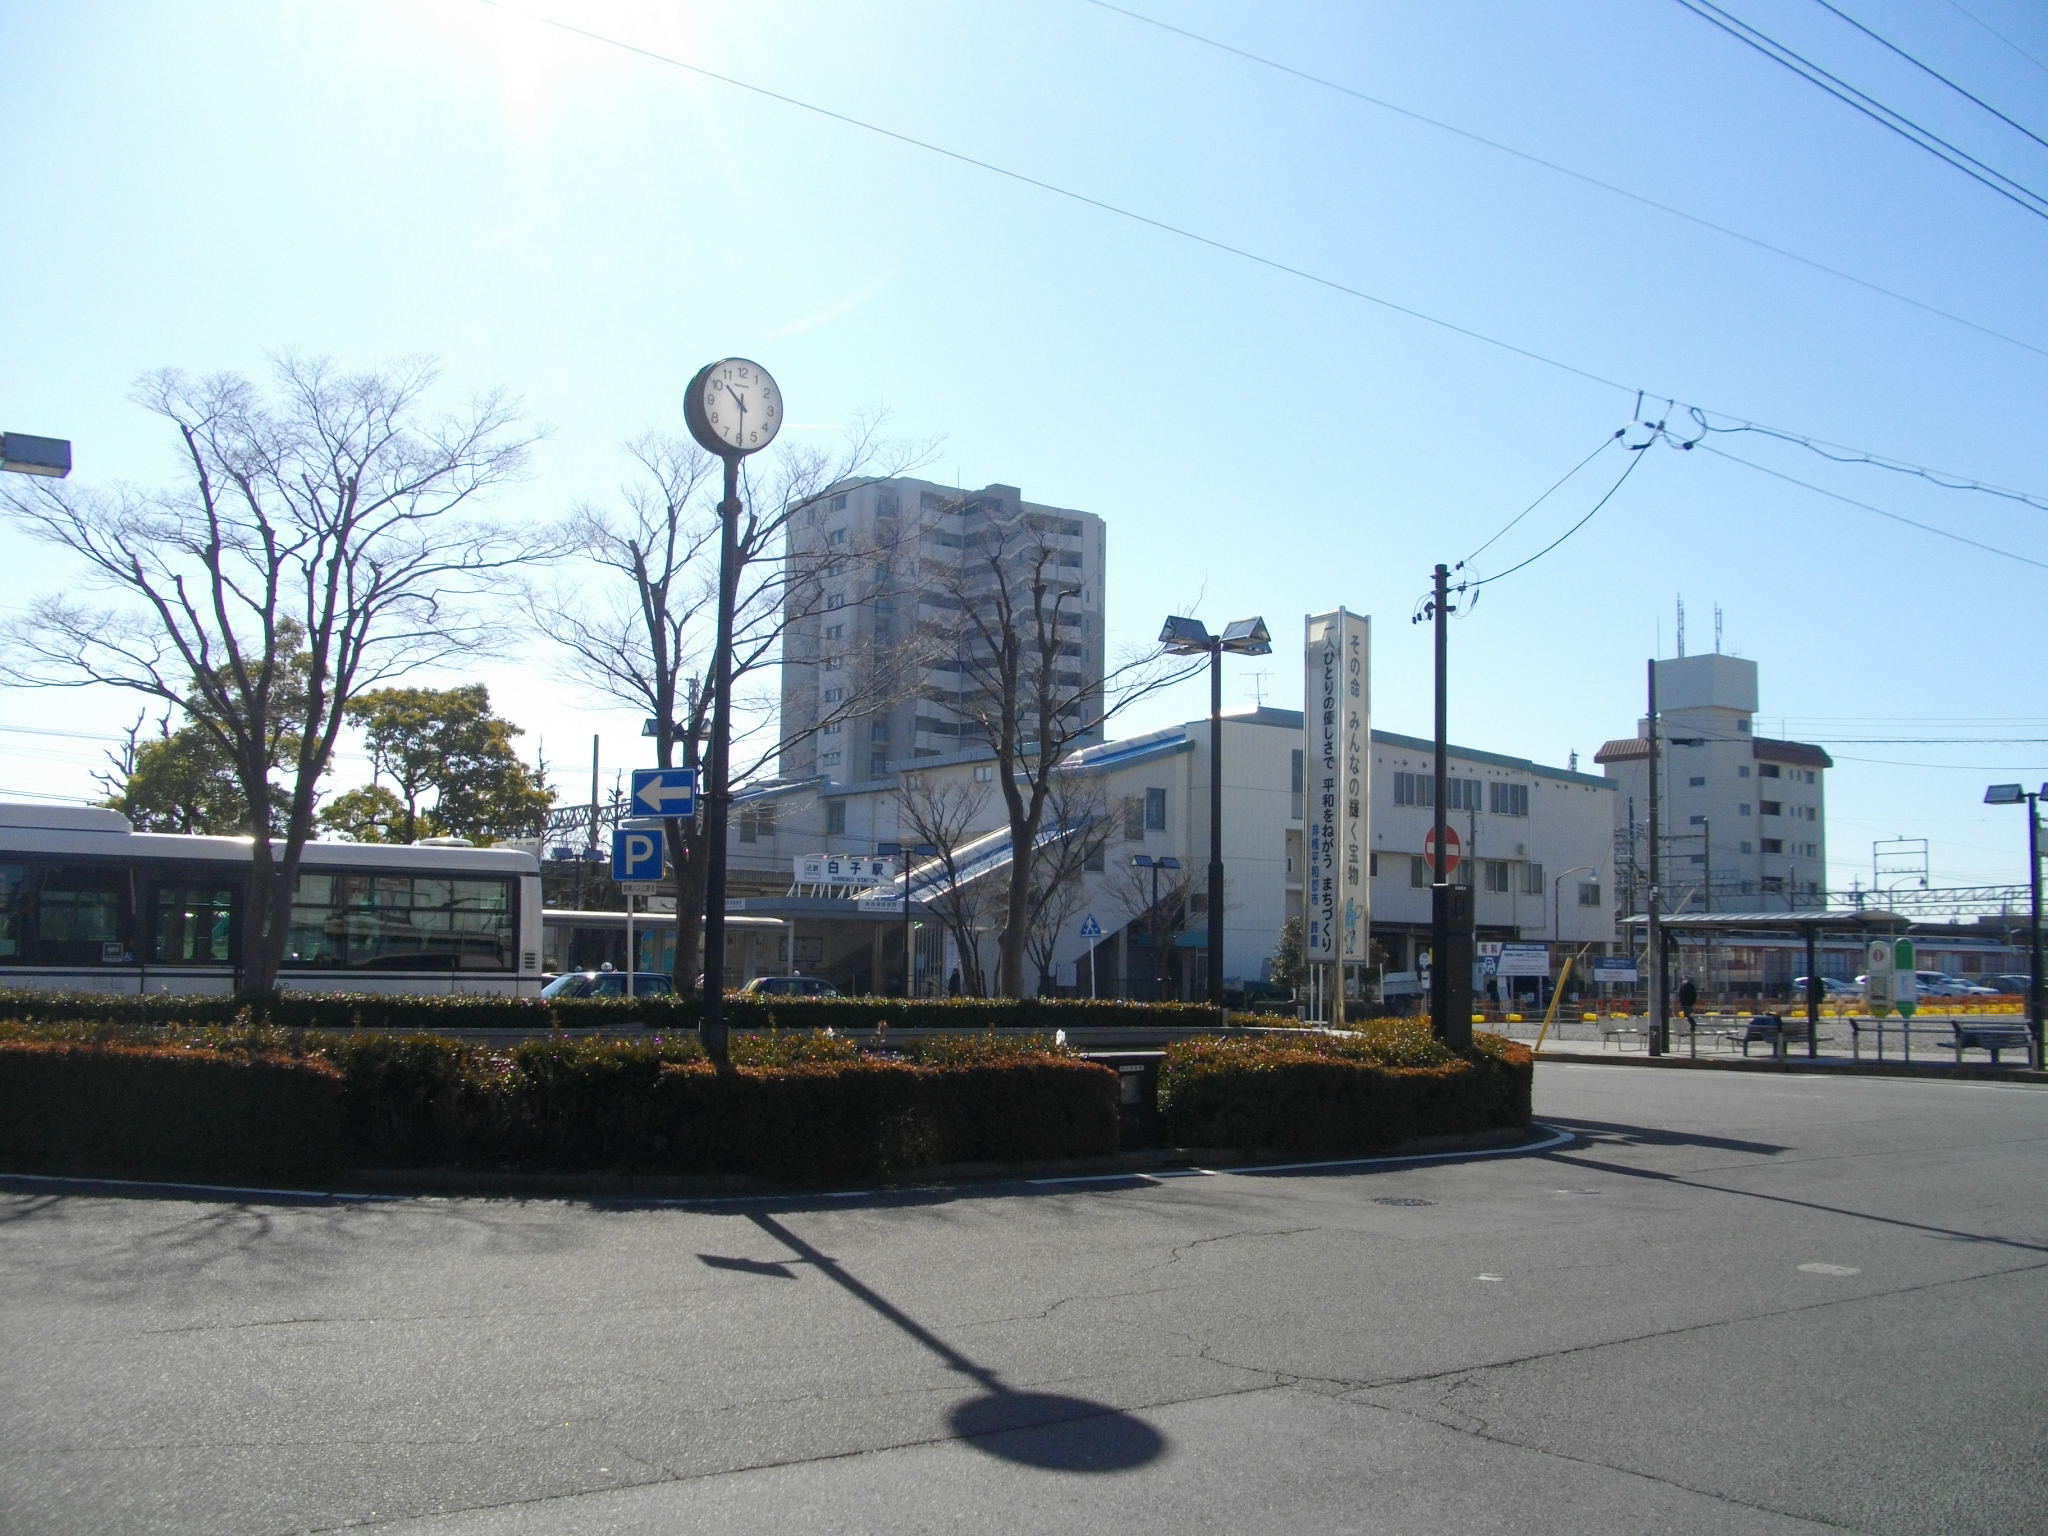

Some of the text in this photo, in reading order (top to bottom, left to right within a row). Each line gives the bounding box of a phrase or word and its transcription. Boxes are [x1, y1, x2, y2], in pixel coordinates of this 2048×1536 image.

[724, 369, 732, 380] 11
[739, 368, 749, 378] 12
[754, 375, 759, 384] 1
[712, 380, 723, 391] 10
[763, 388, 771, 399] 2
[707, 394, 715, 405] 9
[766, 406, 774, 417] 3
[711, 412, 719, 423] 8
[724, 427, 730, 437] 7
[762, 422, 768, 432] 4
[750, 432, 757, 442] 5
[1348, 635, 1360, 886] その命 みんなの輝く宝物
[1322, 626, 1335, 952] 一人ひとりの優しさで 平和をねがう まちづくり
[626, 835, 654, 875] P
[828, 860, 883, 876] 白子駅
